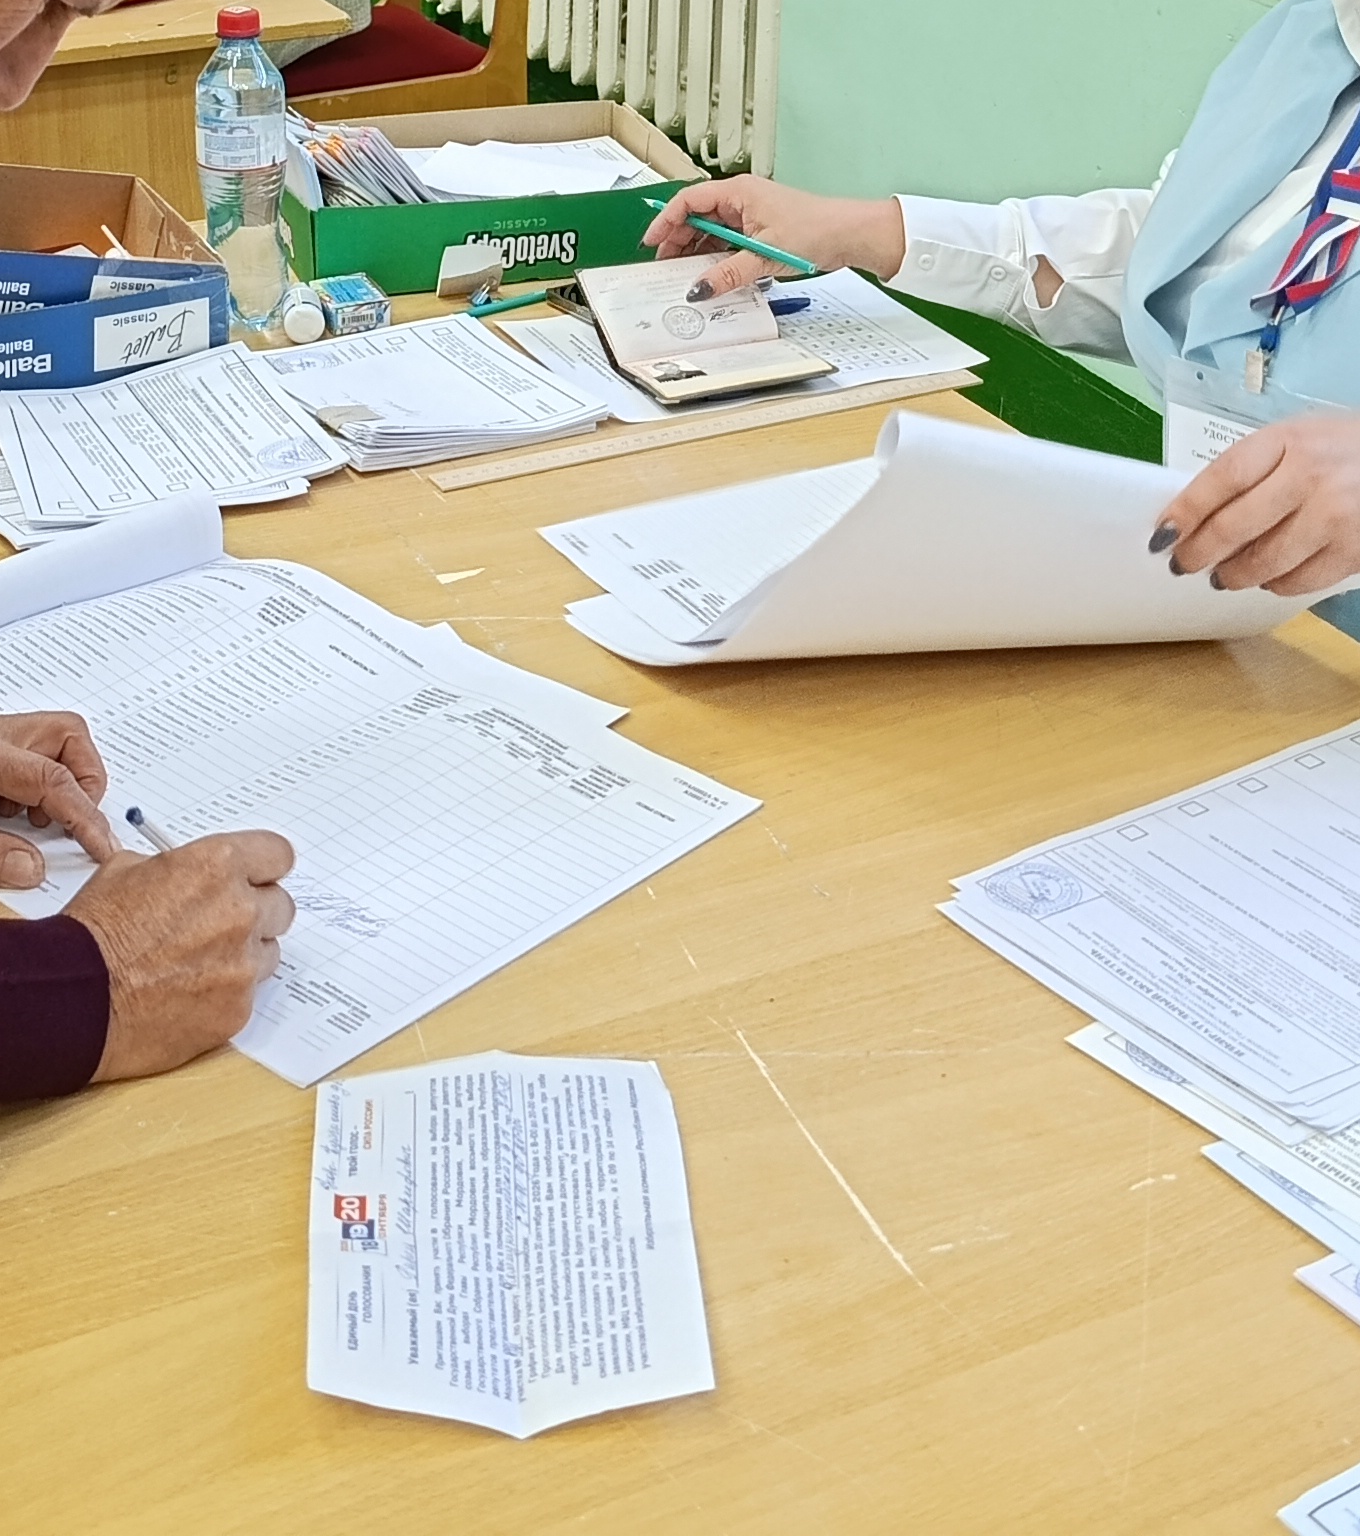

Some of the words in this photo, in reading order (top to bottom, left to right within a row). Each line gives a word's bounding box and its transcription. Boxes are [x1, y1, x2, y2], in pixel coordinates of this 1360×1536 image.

[493, 217, 546, 229] CLASSIC
[112, 312, 156, 327] Classic
[119, 307, 194, 363] Ballet
[363, 1131, 372, 1149] СИЛА
[346, 1155, 358, 1176] ТВОЙ
[441, 1144, 450, 1195] Российской
[530, 1156, 541, 1177] года
[531, 1179, 541, 1202] 2026
[341, 1197, 359, 1220] 20
[349, 1224, 368, 1238] 19
[360, 1240, 379, 1250] 18
[347, 1290, 358, 1311] ДЕНЬ
[361, 1264, 372, 1323] ГОЛОСОВАНИЯ
[407, 1288, 418, 1306] (ая)
[345, 1313, 358, 1350] ЕДИНЫЙ
[407, 1308, 418, 1364] Уважаемый
